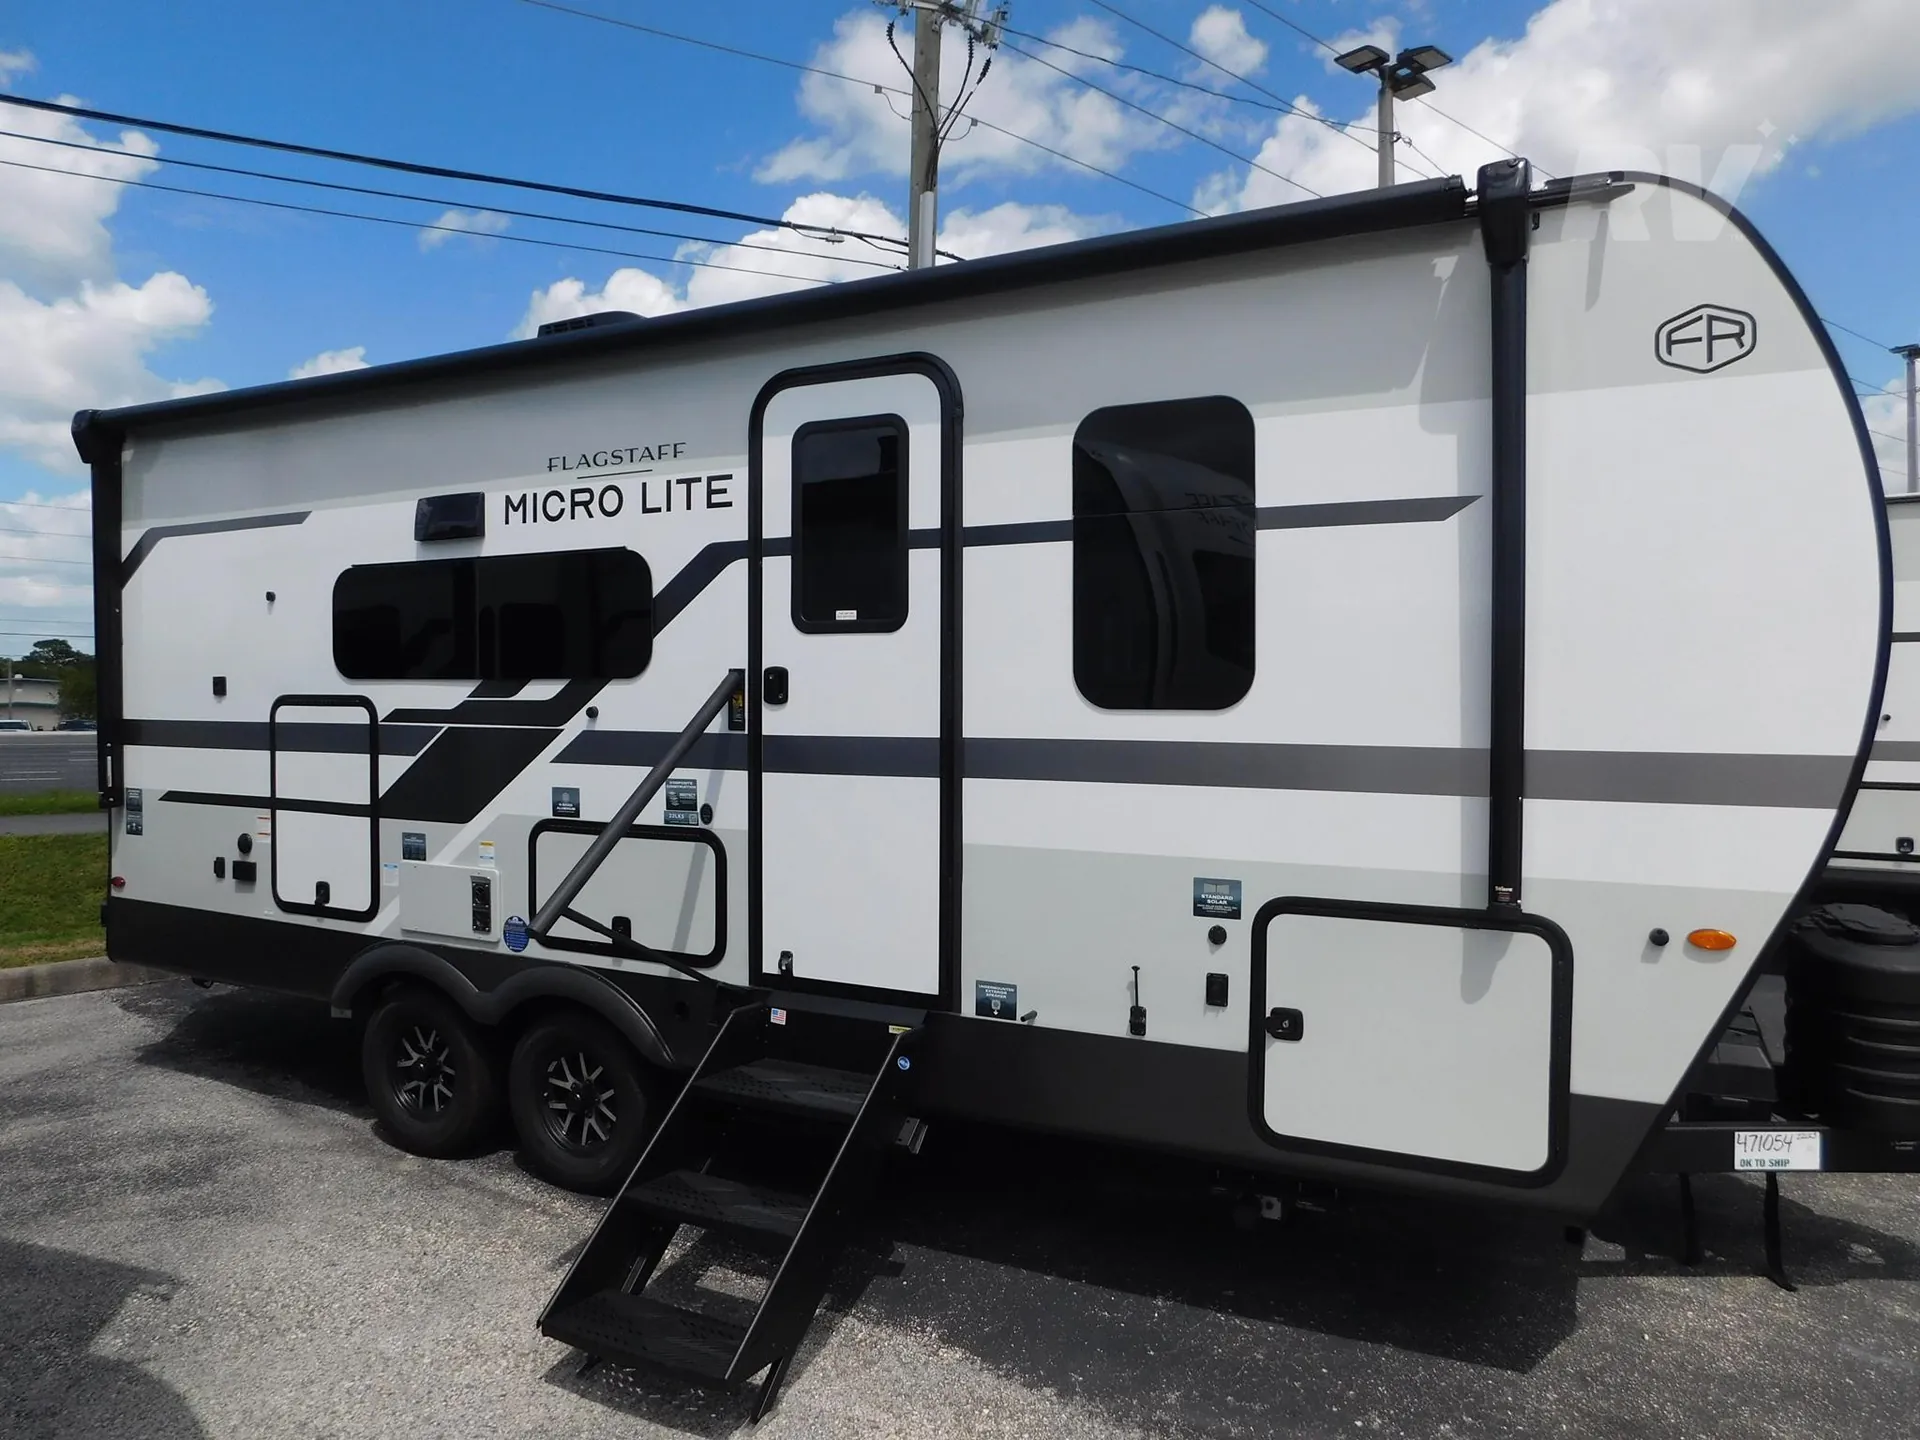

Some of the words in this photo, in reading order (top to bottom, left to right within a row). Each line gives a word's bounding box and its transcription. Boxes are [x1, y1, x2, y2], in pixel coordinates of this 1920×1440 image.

[547, 442, 687, 472] FLAGSTAFF
[504, 484, 624, 525] MICRO
[641, 474, 733, 514] LITE
[1201, 893, 1234, 901] STANDARD
[1736, 1132, 1793, 1153] 471054
[1739, 1159, 1752, 1168] OK
[1754, 1159, 1766, 1168] TO
[1768, 1159, 1790, 1168] SHIP
